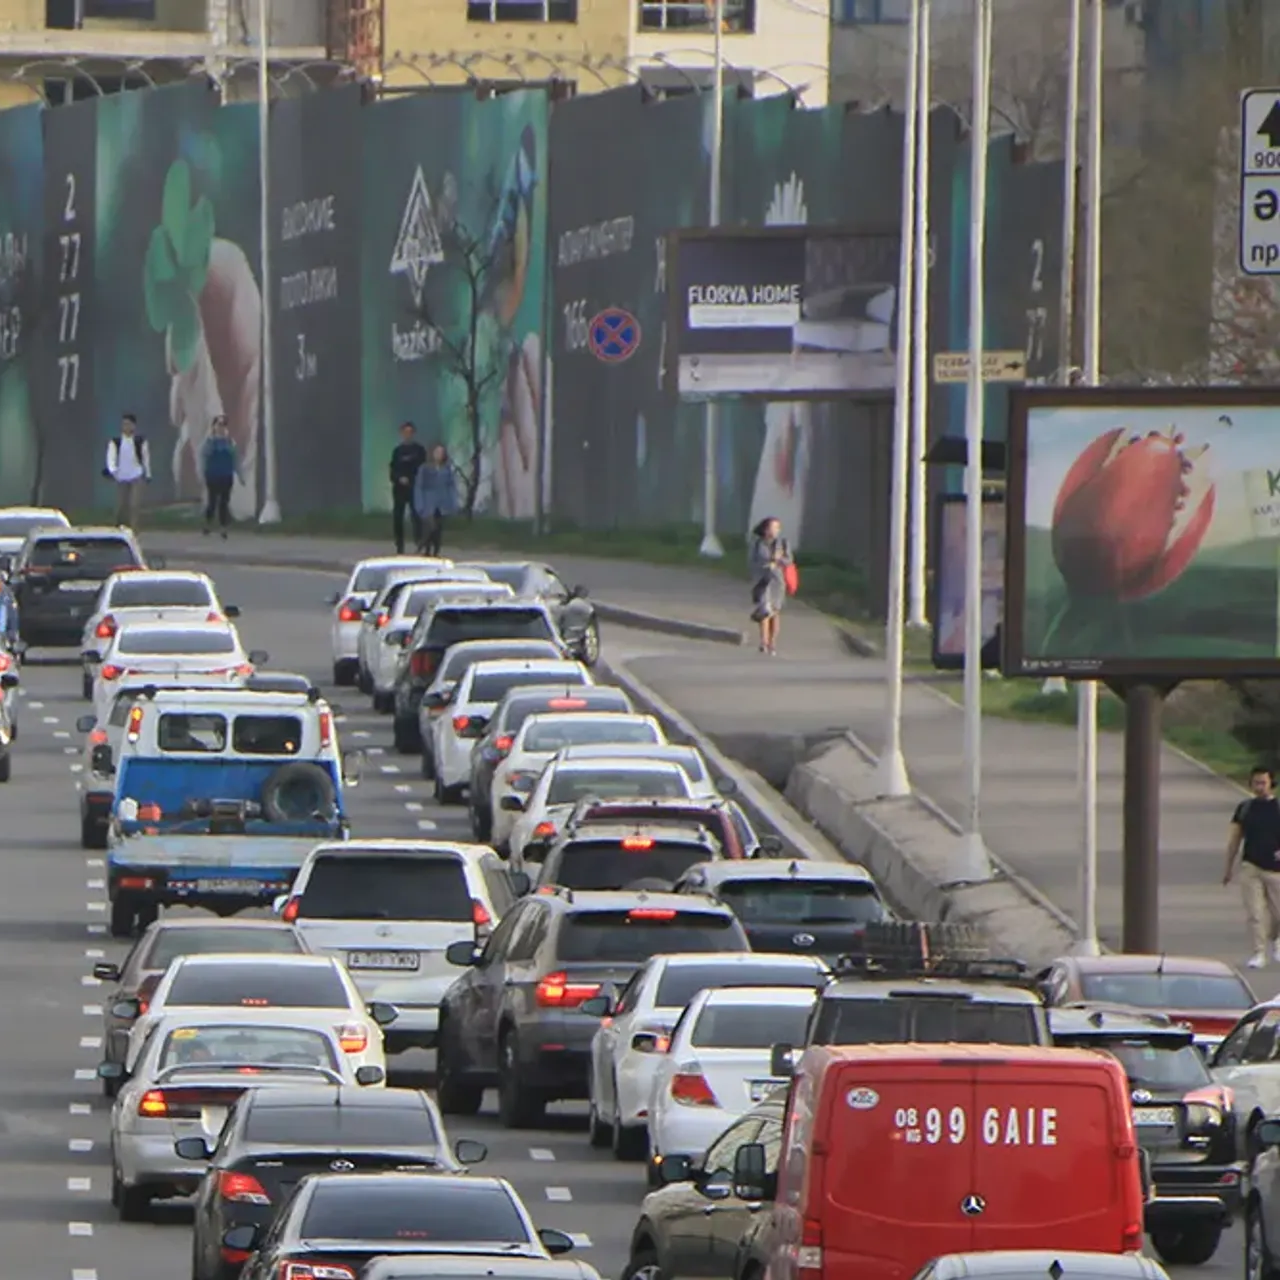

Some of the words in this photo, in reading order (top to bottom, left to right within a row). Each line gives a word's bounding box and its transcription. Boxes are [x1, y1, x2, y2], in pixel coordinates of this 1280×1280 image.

[65, 173, 76, 221] 2
[59, 232, 81, 282] 77
[59, 293, 81, 342] 77
[752, 284, 801, 303] HOME
[58, 353, 80, 402] 77
[895, 1108, 918, 1128] 08
